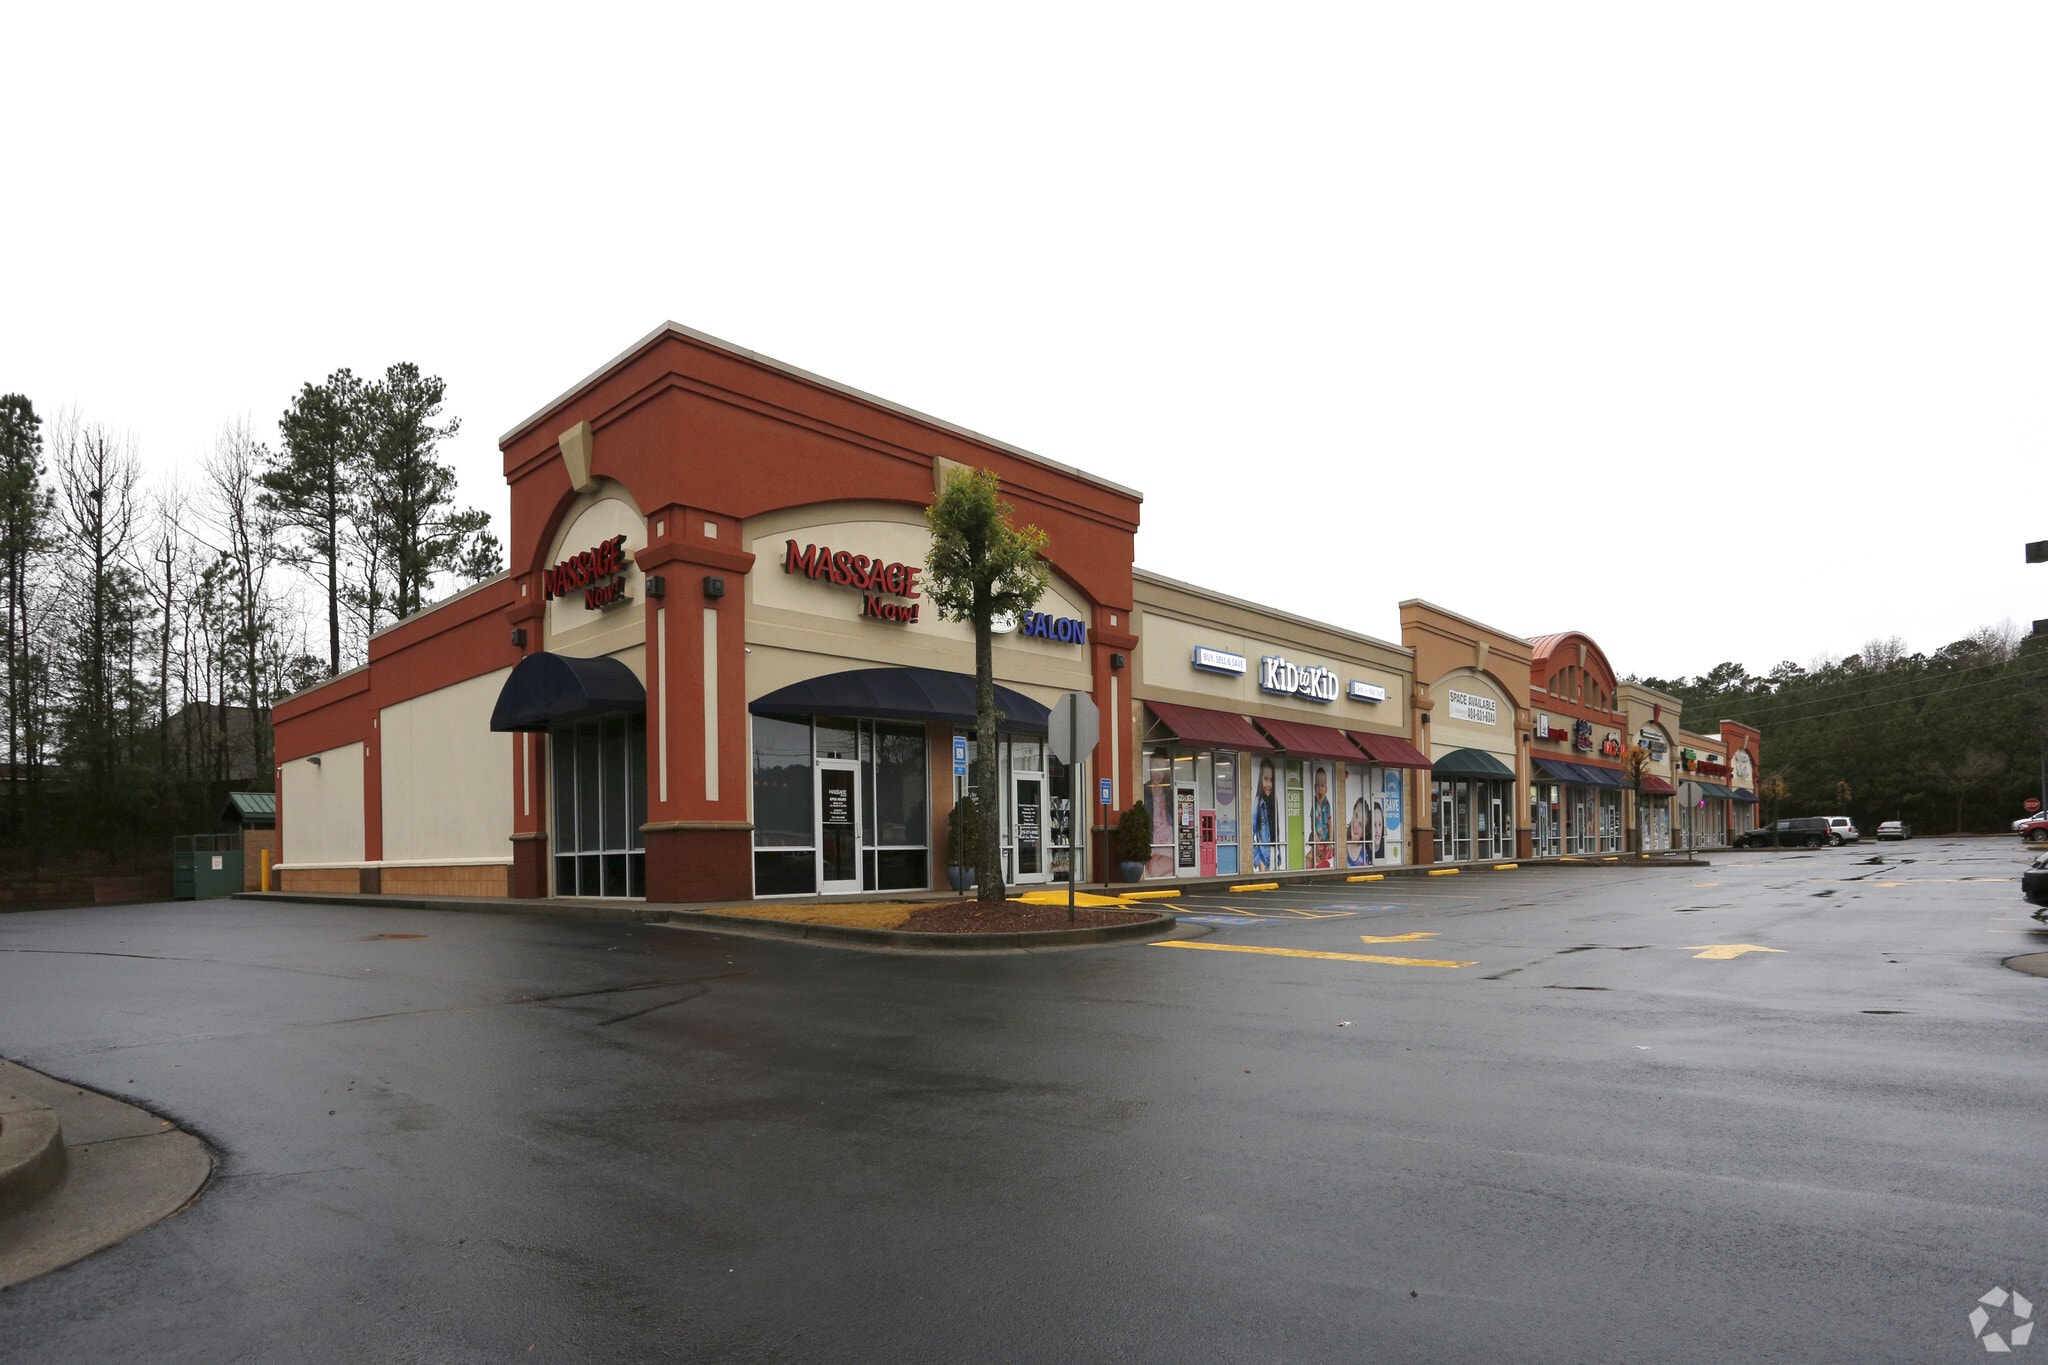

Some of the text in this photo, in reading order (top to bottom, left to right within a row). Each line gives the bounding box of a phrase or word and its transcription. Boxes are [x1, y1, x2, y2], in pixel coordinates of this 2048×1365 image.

[543, 534, 626, 600] MASSAGE
[785, 538, 922, 599] MASSAGE
[1019, 610, 1085, 645] SALON
[1215, 655, 1227, 665] SELL
[1231, 658, 1244, 669] SAVE
[1450, 691, 1467, 705] SPACE
[1468, 696, 1495, 711] AVAILABLE
